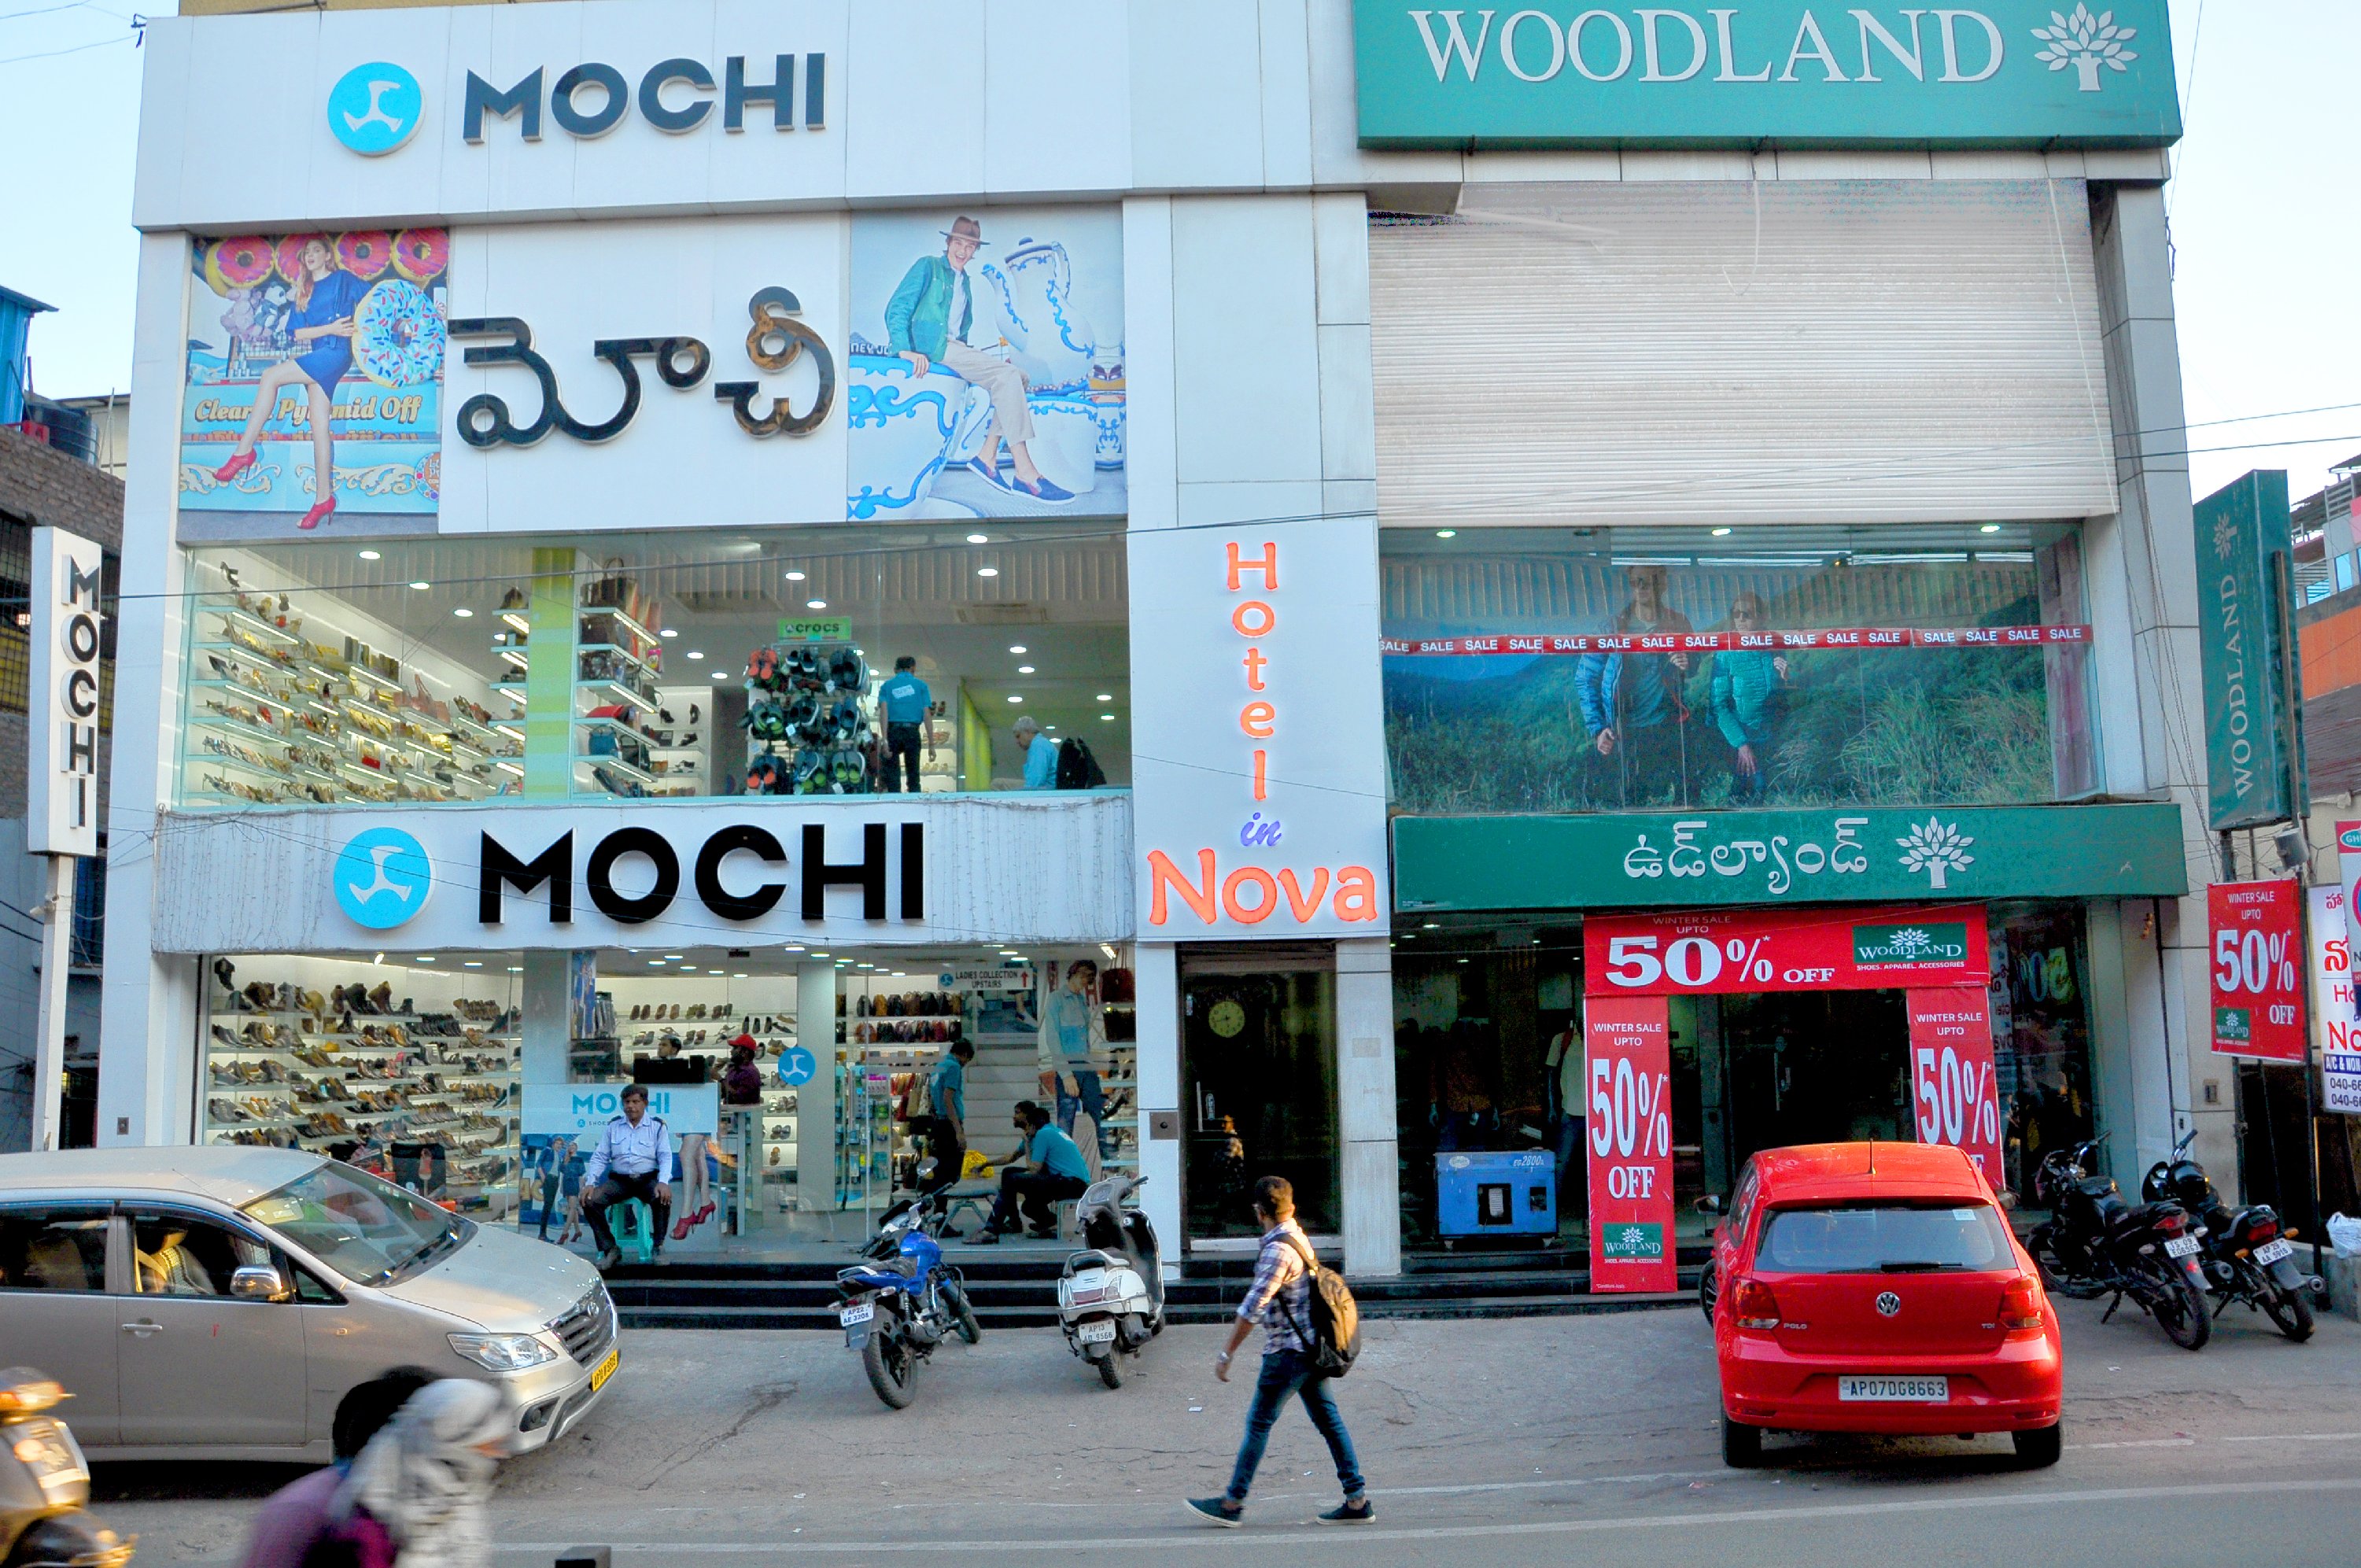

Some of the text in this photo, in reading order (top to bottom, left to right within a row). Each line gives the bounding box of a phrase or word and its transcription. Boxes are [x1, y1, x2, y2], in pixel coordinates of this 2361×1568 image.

[1408, 6, 2005, 84] WOODLAND
[463, 53, 826, 144] MOCHI
[381, 395, 422, 424] Off
[795, 623, 839, 633] crocs
[1421, 641, 1453, 652] SALE
[1465, 640, 1497, 651] SALE
[1510, 639, 1542, 649] SALE
[1554, 638, 1586, 649] SALE
[1598, 637, 1630, 648] SALE
[1642, 636, 1674, 647] SALE
[1685, 636, 1717, 647] SALE
[1740, 634, 1773, 646] SALE
[1784, 633, 1816, 644] SALE
[1827, 632, 1858, 643] SALE
[1869, 632, 1900, 643] SALE
[1924, 632, 1955, 643] SALE
[1966, 630, 1998, 641] SALE
[2008, 629, 2039, 640] SALE
[2049, 628, 2082, 640] SALE
[1226, 541, 1278, 801] Hotel
[62, 554, 101, 828] MOCHI
[2220, 575, 2254, 799] WOODLAND
[1240, 813, 1282, 847] in
[479, 822, 924, 924] MOCHI
[1147, 847, 1377, 925] Nova
[2228, 891, 2274, 903] WINTER SALE
[1702, 915, 1731, 924] SALE
[2241, 909, 2261, 920] UPTO
[1857, 944, 1962, 960] WOODLAND
[956, 971, 977, 980] LADIES
[1783, 968, 1835, 983] OFF
[1916, 1012, 1983, 1023] WINTER SALE
[2269, 1005, 2295, 1024] OFF
[1594, 1023, 1662, 1033] WINTER SALE
[1937, 1027, 1964, 1035] UPTO
[2216, 1025, 2248, 1038] WOODLAND
[1614, 1037, 1643, 1046] UPTO
[2339, 1057, 2346, 1071] &
[572, 1092, 670, 1115] MOHI
[1608, 1165, 1655, 1199] OFF
[1606, 1242, 1661, 1254] WOODLAND
[1089, 1324, 1105, 1333] AP13
[1850, 1381, 1946, 1396] AP07DG8663
